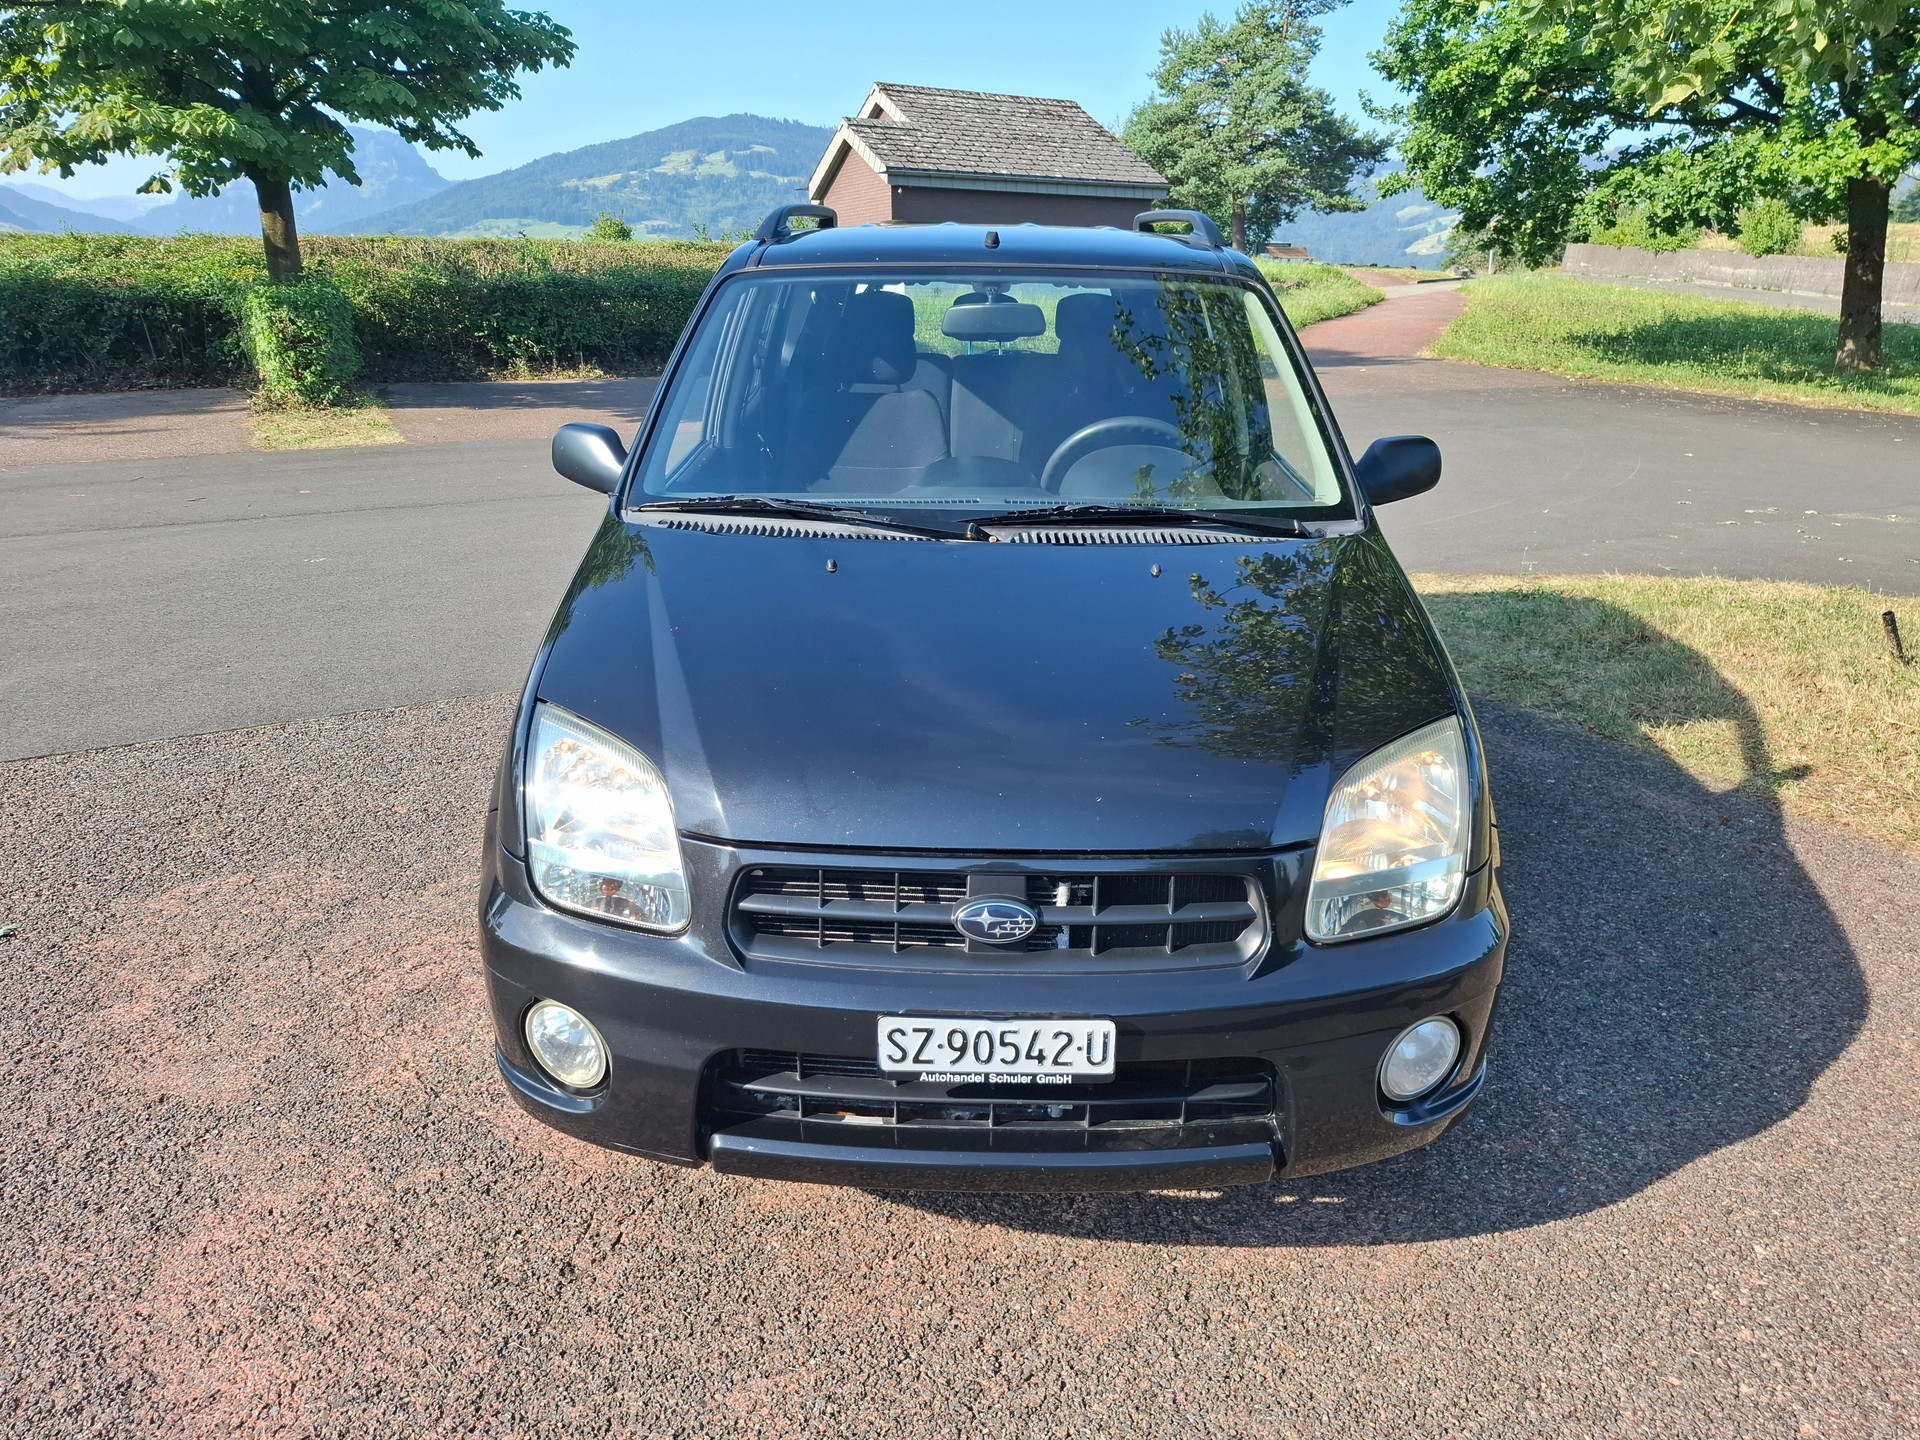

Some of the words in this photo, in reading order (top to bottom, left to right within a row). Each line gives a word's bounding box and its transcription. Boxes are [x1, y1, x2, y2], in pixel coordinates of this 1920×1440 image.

[919, 1071, 985, 1084] Autohandel
[988, 1073, 1033, 1084] Schuler
[1036, 1074, 1072, 1085] GmbH
